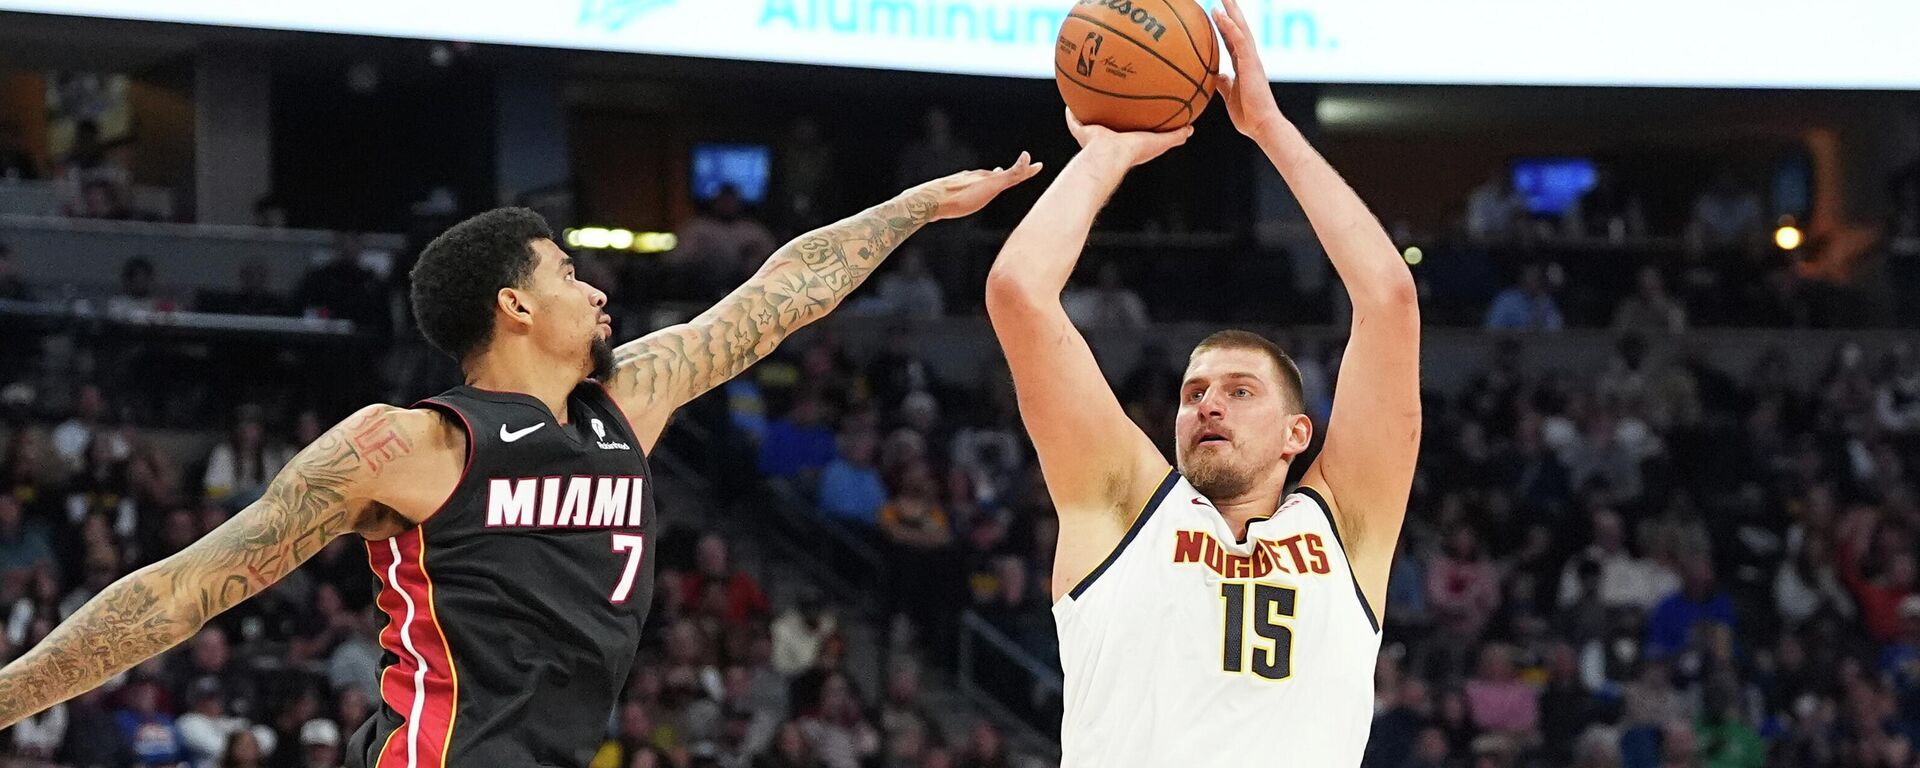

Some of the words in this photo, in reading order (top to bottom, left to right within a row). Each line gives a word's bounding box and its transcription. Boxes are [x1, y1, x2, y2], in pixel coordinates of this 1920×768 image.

[485, 475, 643, 528] MIAMI
[609, 532, 645, 605] 7
[1219, 580, 1298, 683] 15
